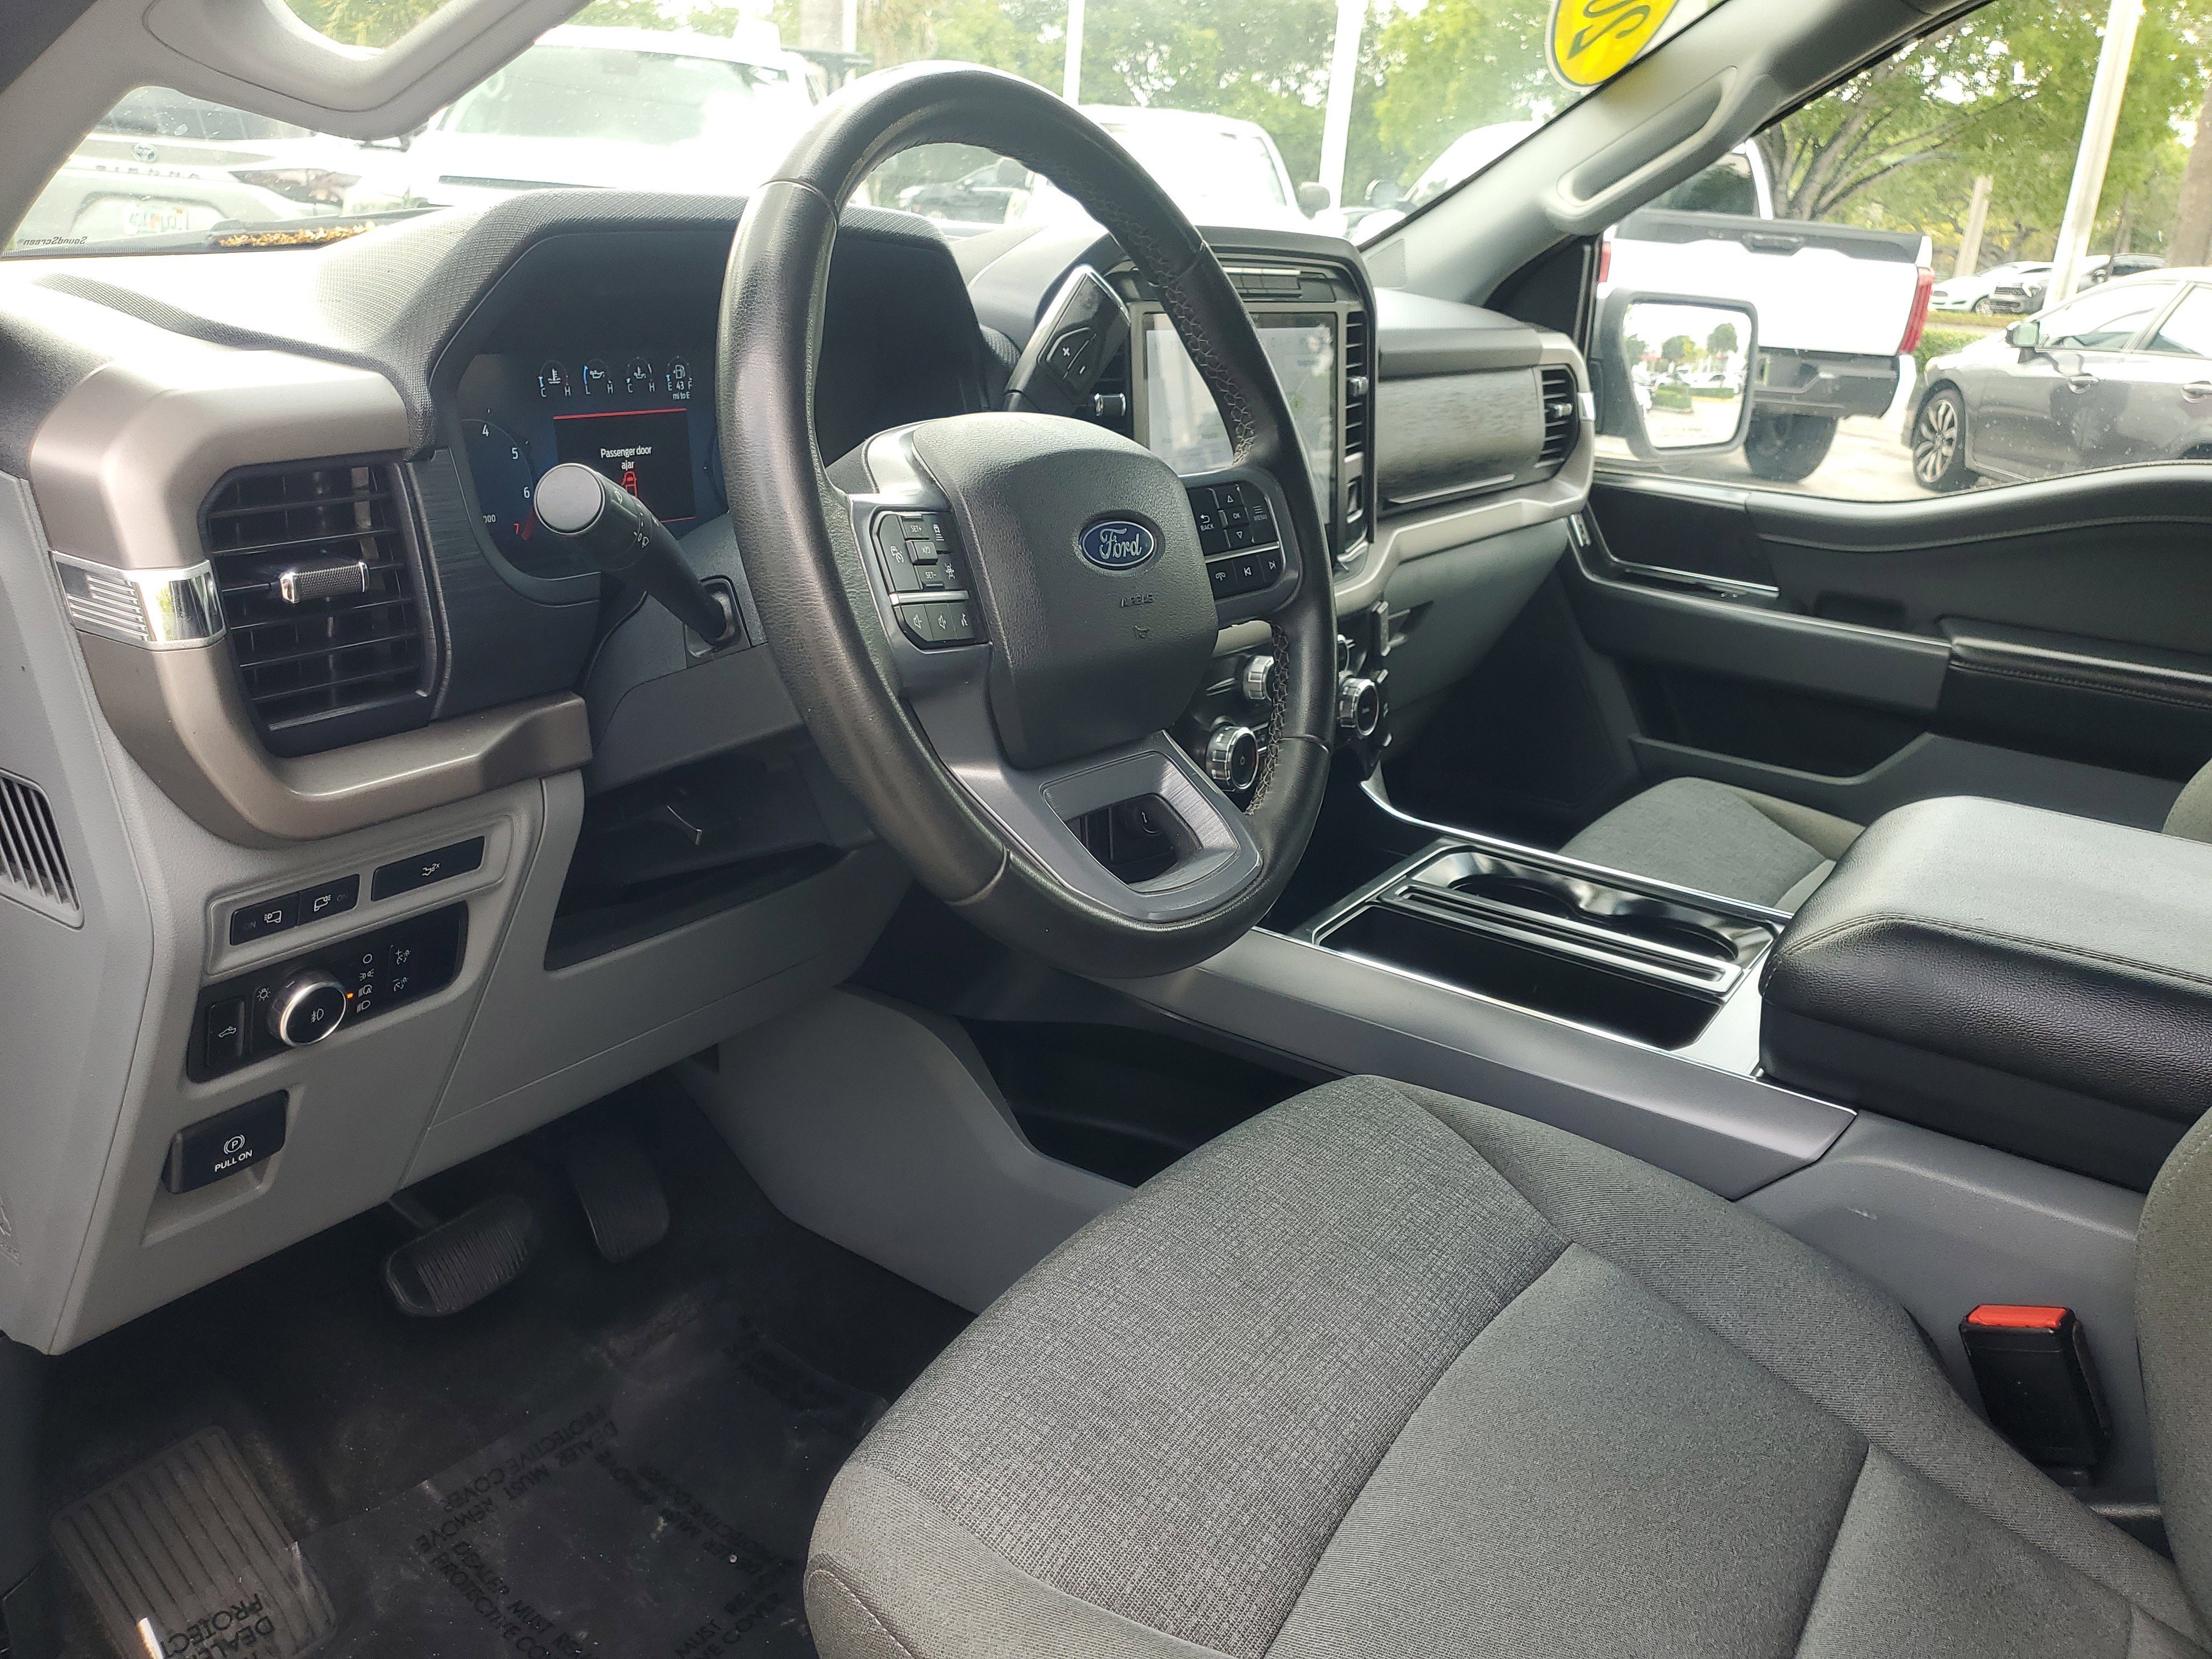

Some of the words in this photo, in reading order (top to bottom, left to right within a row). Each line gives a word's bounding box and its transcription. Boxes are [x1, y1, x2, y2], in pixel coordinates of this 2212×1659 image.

[565, 386, 571, 397] H
[607, 384, 613, 394] H
[648, 382, 655, 392] H
[676, 381, 685, 391] 43
[540, 387, 546, 398] C
[482, 424, 489, 437] 4
[511, 447, 518, 460] 5
[601, 448, 635, 459] Passenger
[636, 445, 652, 455] door
[621, 460, 635, 471] ajar
[523, 487, 530, 499] 6
[514, 523, 520, 535] 7
[1200, 523, 1215, 532] BACK
[1099, 528, 1142, 560] Ford
[215, 1157, 238, 1172] PULL
[238, 1149, 252, 1161] ON
[503, 1463, 551, 1501] MUST
[443, 1467, 506, 1513] COVER
